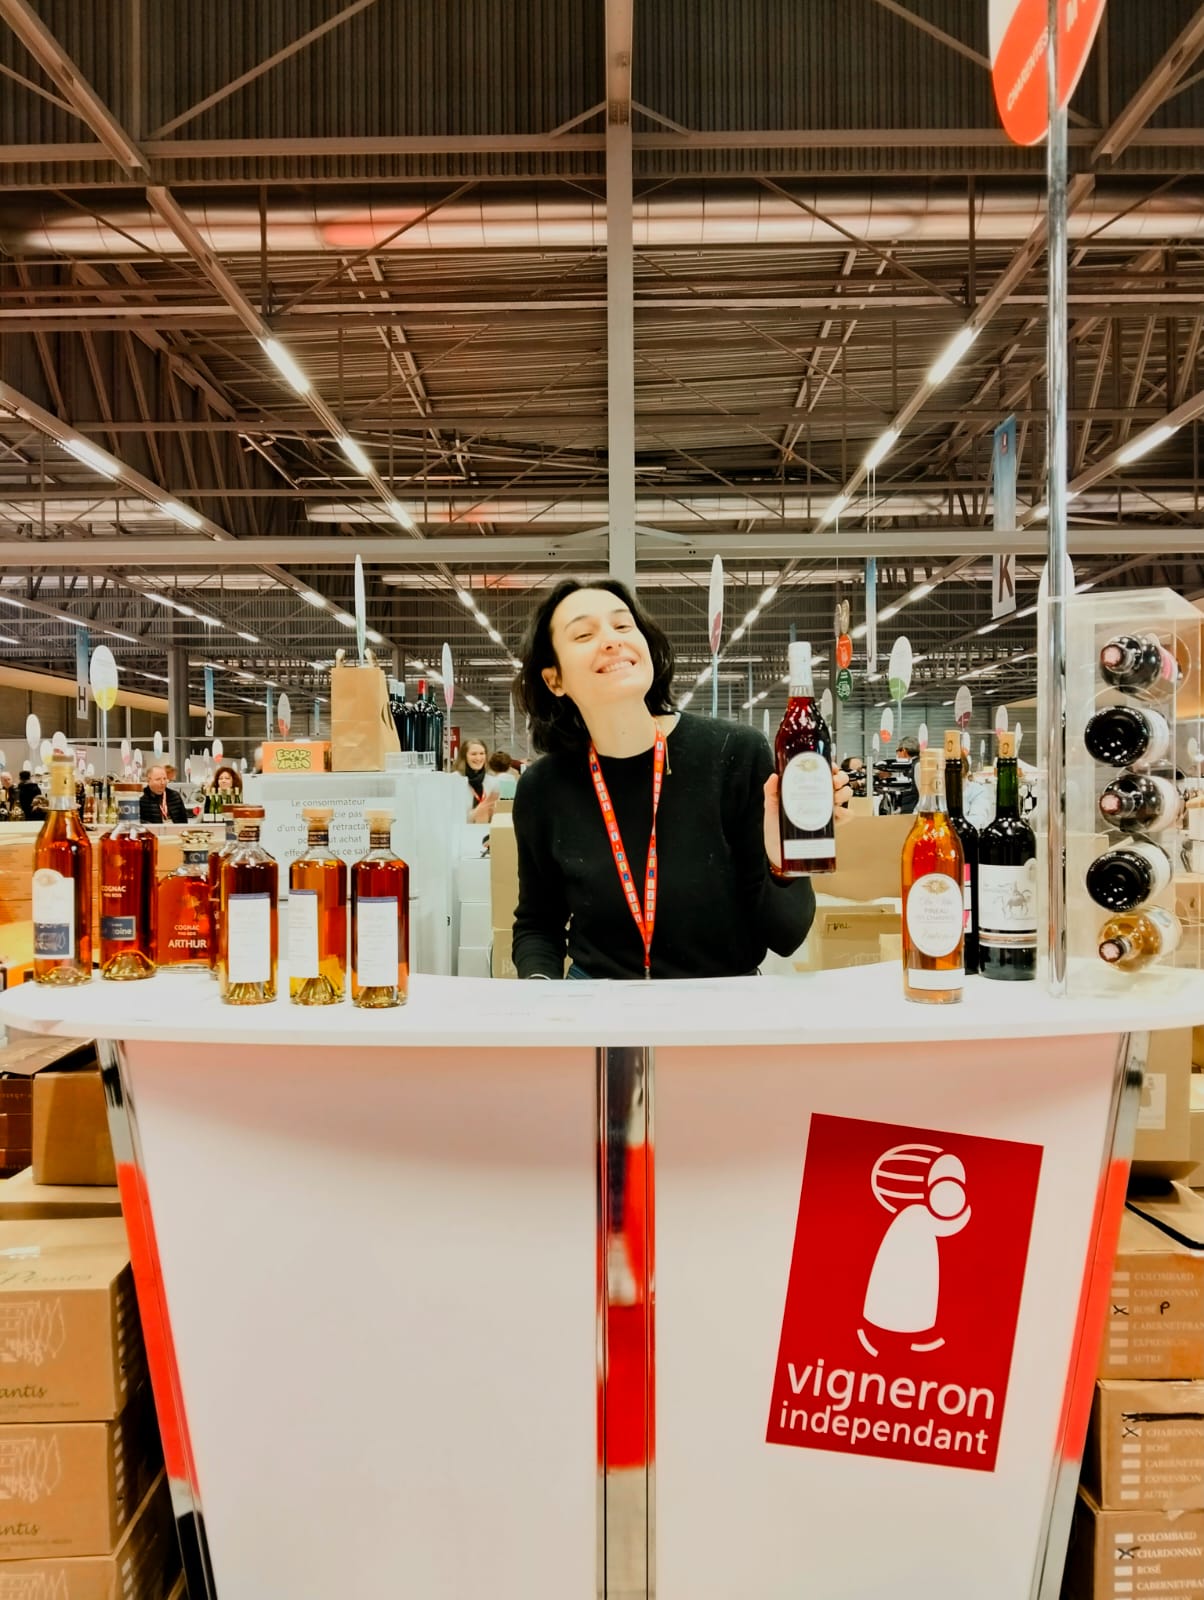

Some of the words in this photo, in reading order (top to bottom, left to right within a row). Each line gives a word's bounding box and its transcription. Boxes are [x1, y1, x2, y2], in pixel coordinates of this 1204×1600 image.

[998, 554, 1014, 603] K
[78, 686, 86, 712] H
[302, 798, 366, 807] consommateur
[276, 824, 296, 832] d'un
[339, 834, 362, 843] achat
[168, 939, 208, 949] ARTHUR
[787, 1358, 995, 1420] vigneron
[779, 1400, 989, 1455] independant
[1137, 1546, 1203, 1559] CHARDONNAY
